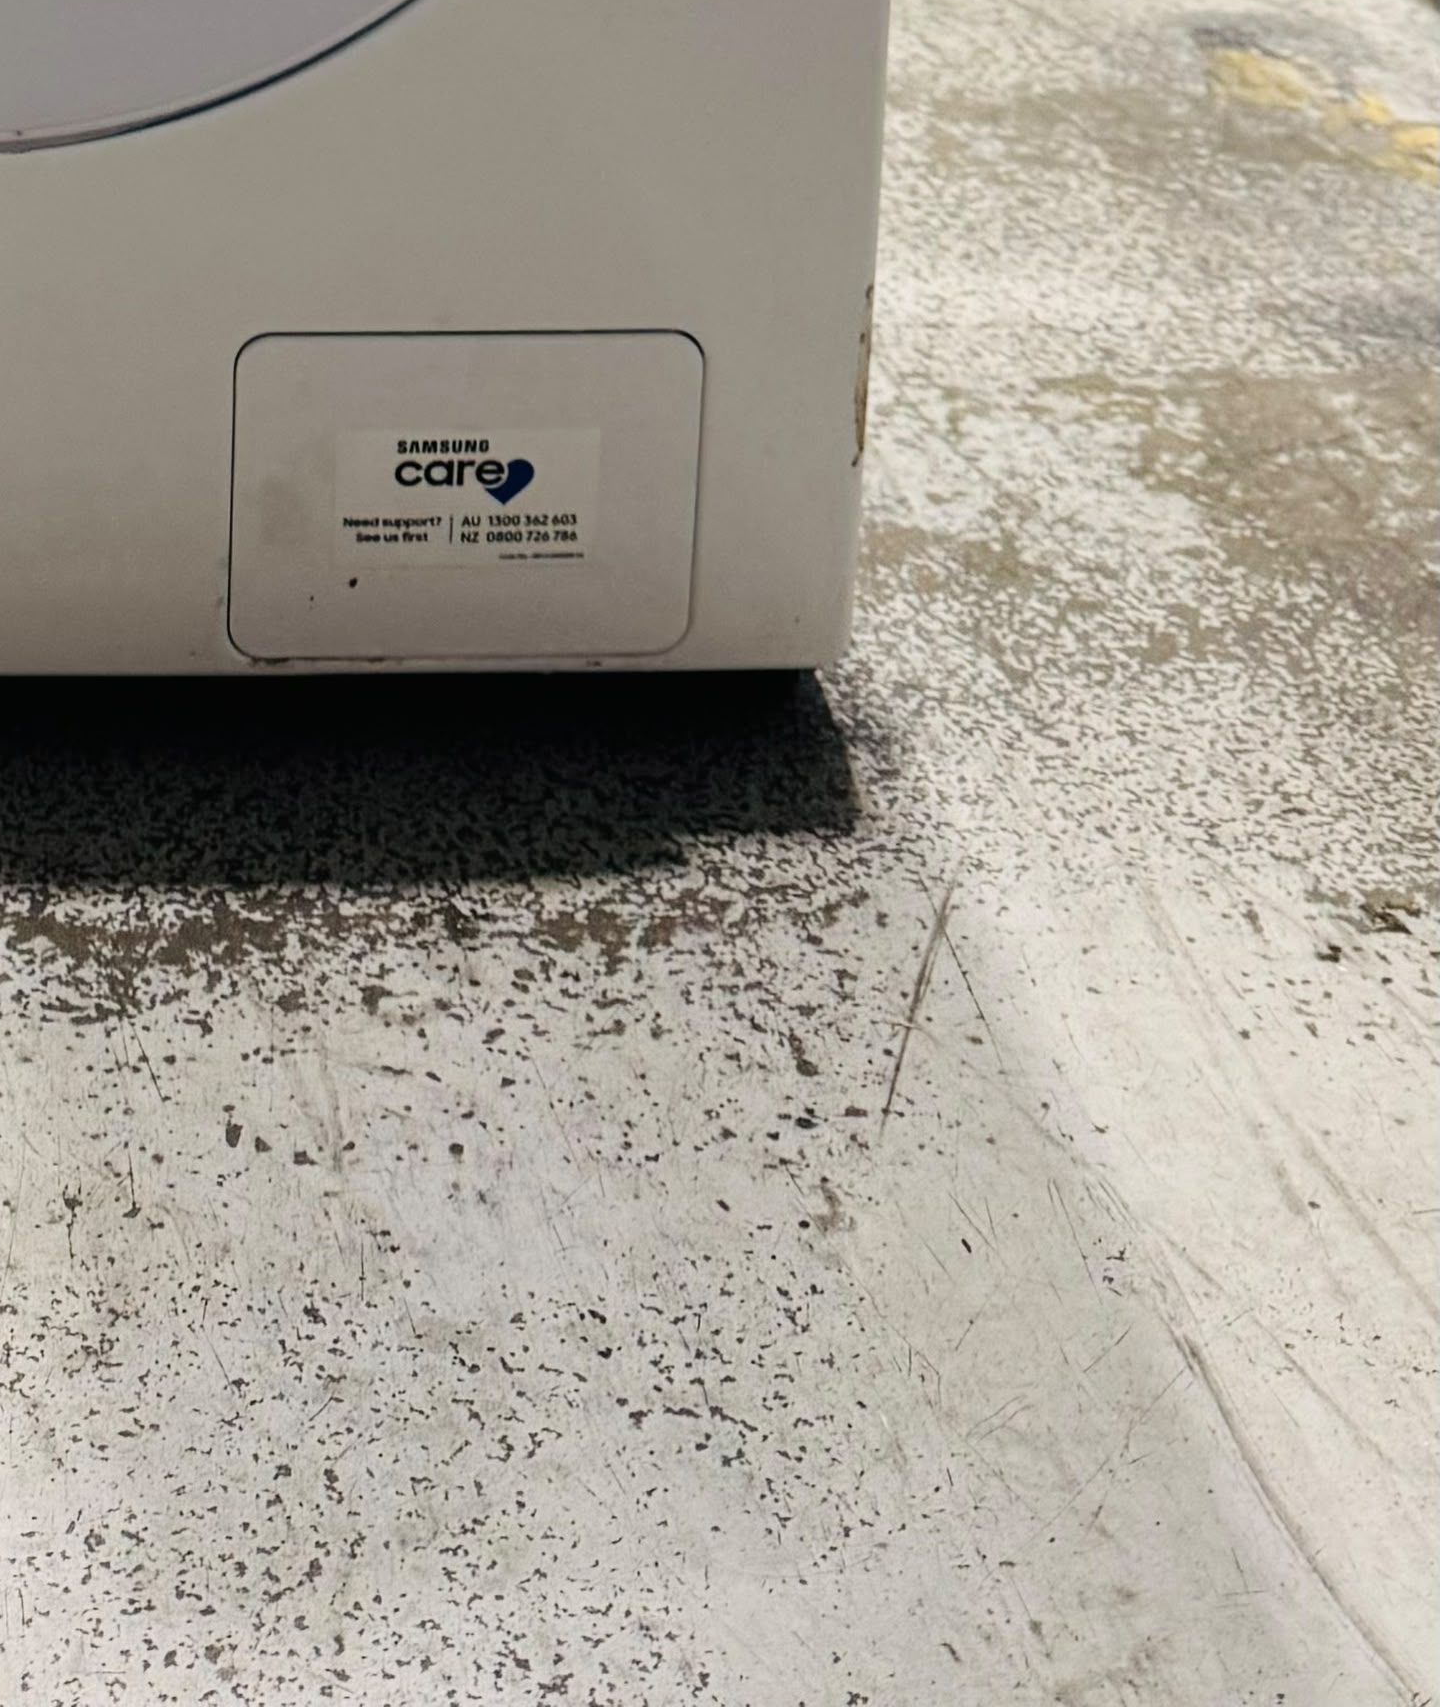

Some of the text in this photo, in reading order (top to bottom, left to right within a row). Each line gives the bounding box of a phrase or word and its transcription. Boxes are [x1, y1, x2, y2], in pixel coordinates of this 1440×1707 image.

[397, 439, 489, 454] SAMSUNG
[394, 459, 506, 487] care
[343, 516, 442, 530] Need support?
[461, 514, 577, 527] AU 1300 362 603
[356, 532, 429, 543] See us first
[460, 531, 578, 544] NZ 0800 726 786
